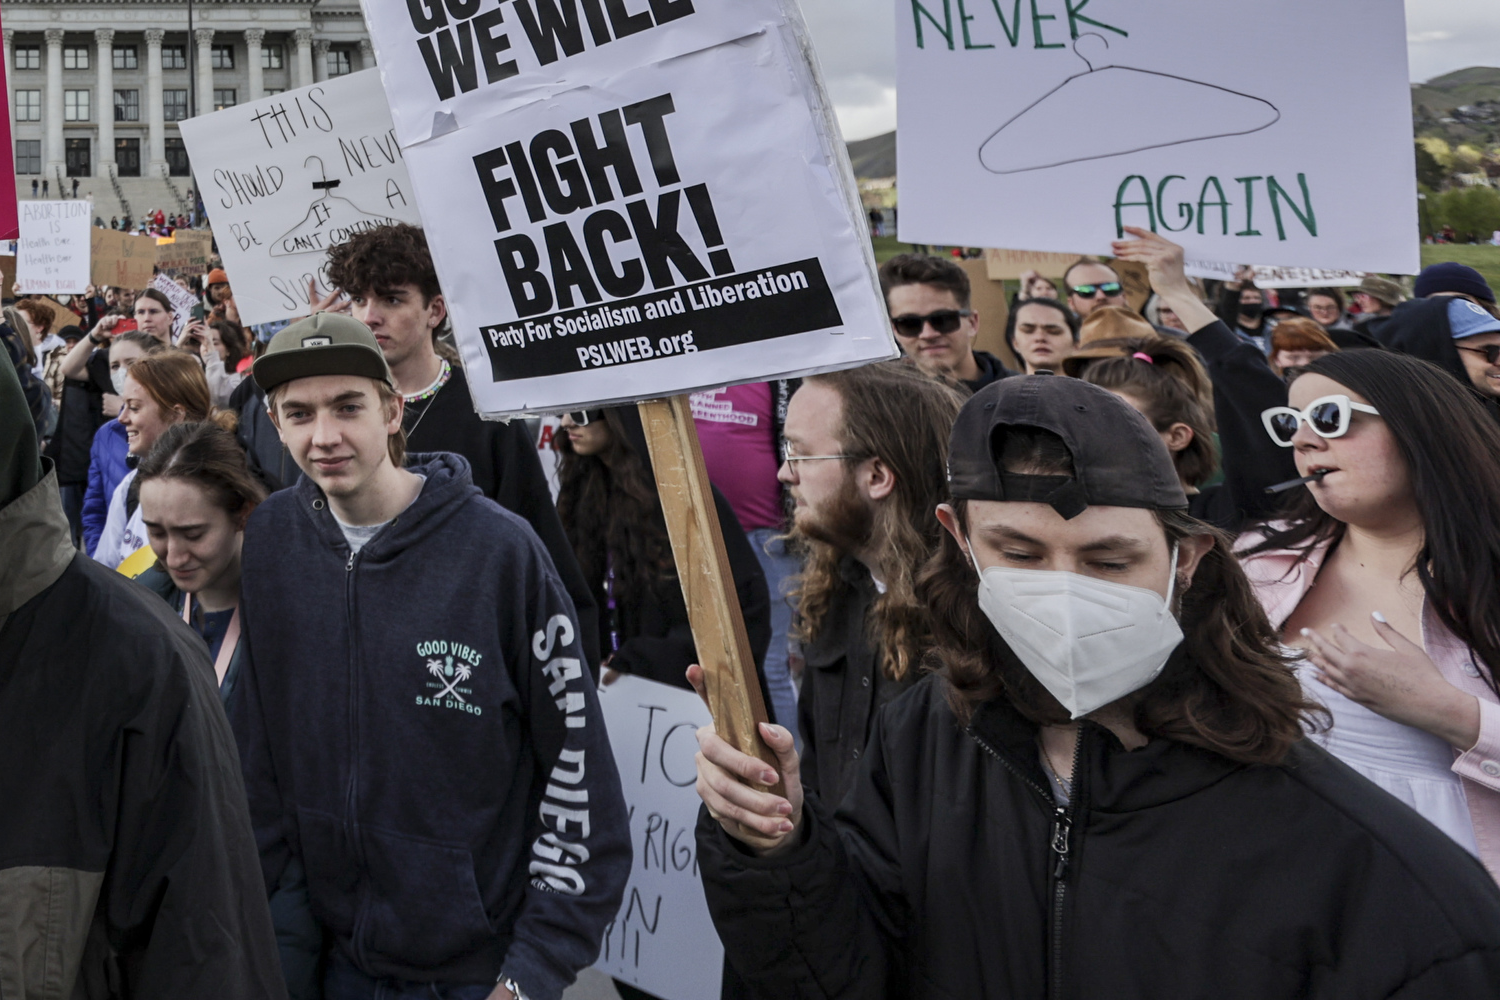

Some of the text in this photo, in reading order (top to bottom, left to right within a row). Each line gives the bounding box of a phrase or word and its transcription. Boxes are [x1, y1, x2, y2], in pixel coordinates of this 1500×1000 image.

[417, 7, 520, 101] WE
[250, 86, 333, 149] THIS
[213, 164, 284, 209] SHOULD
[472, 93, 681, 233] FIGHT
[23, 202, 87, 222] ABORTION
[49, 220, 62, 234] IS
[1112, 173, 1318, 241] AGAIN
[228, 220, 263, 252] BE
[494, 182, 736, 319] BACK!
[488, 270, 809, 348] Party For Socialism and Liberation
[576, 330, 699, 368] PSLWEB.org
[416, 640, 482, 667] GOOD VIBES
[415, 695, 482, 716] SAN DIEGO
[529, 748, 591, 897] DIEGO
